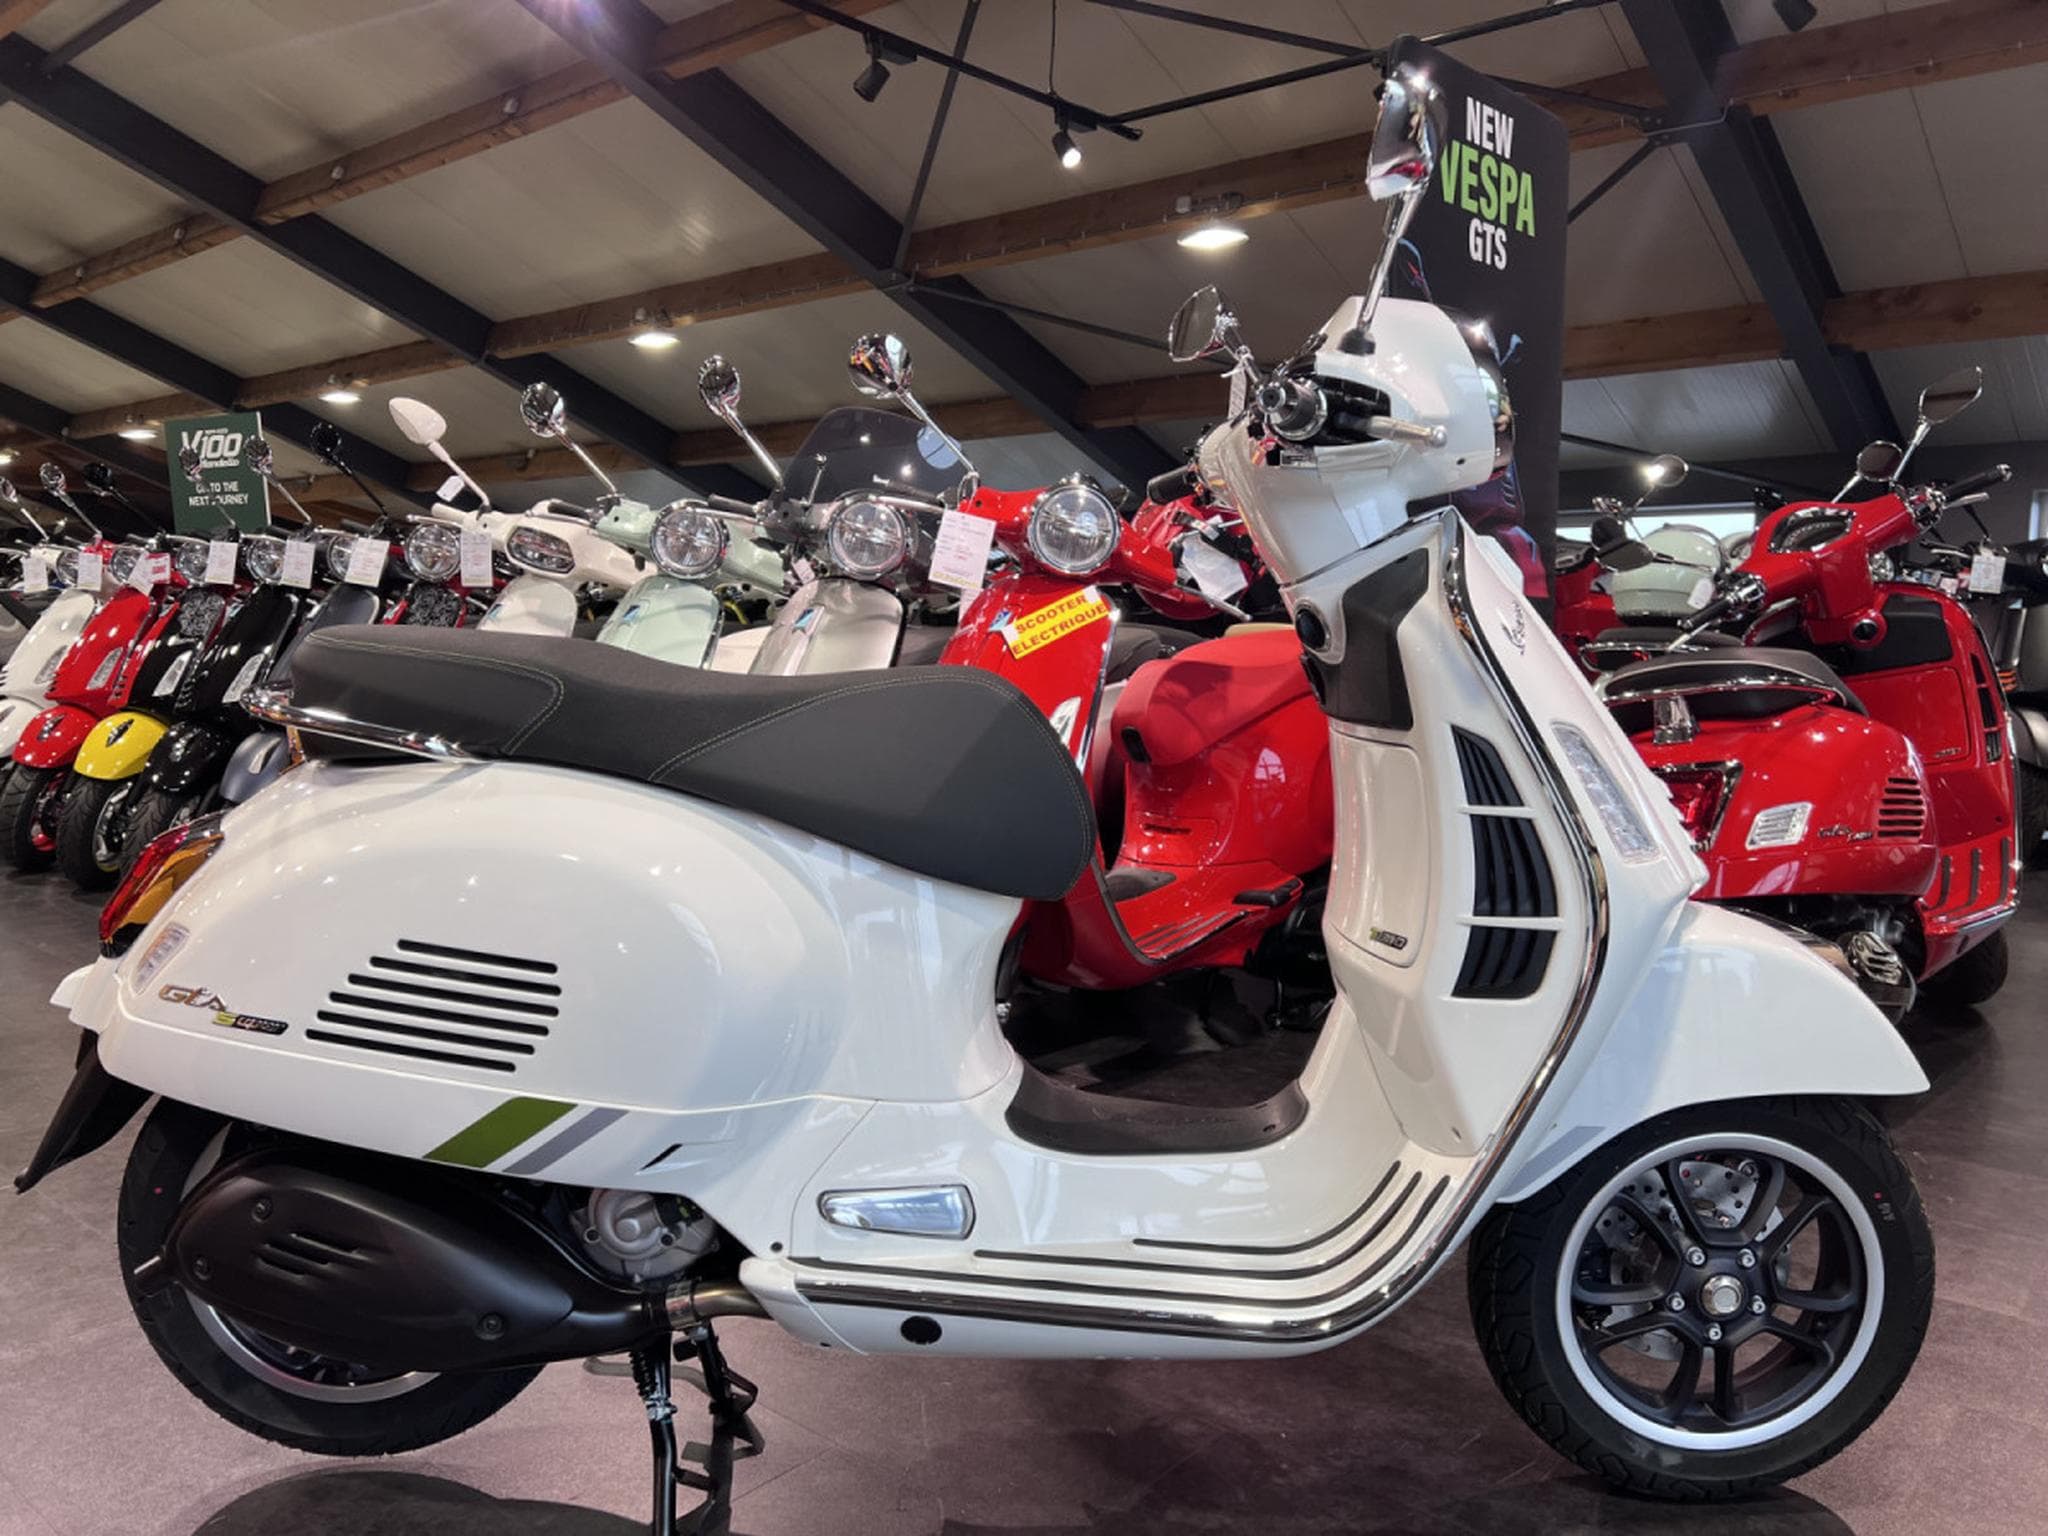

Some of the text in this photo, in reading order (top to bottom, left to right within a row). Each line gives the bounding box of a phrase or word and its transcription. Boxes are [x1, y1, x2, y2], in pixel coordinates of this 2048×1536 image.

[1466, 96, 1514, 159] NEW
[1440, 139, 1536, 237] VESPA
[1468, 218, 1507, 271] GTS
[181, 429, 243, 459] V100
[188, 495, 210, 506] NEXT
[1012, 603, 1107, 654] ELECTRIQUE
[1015, 594, 1088, 634] SCOOTER
